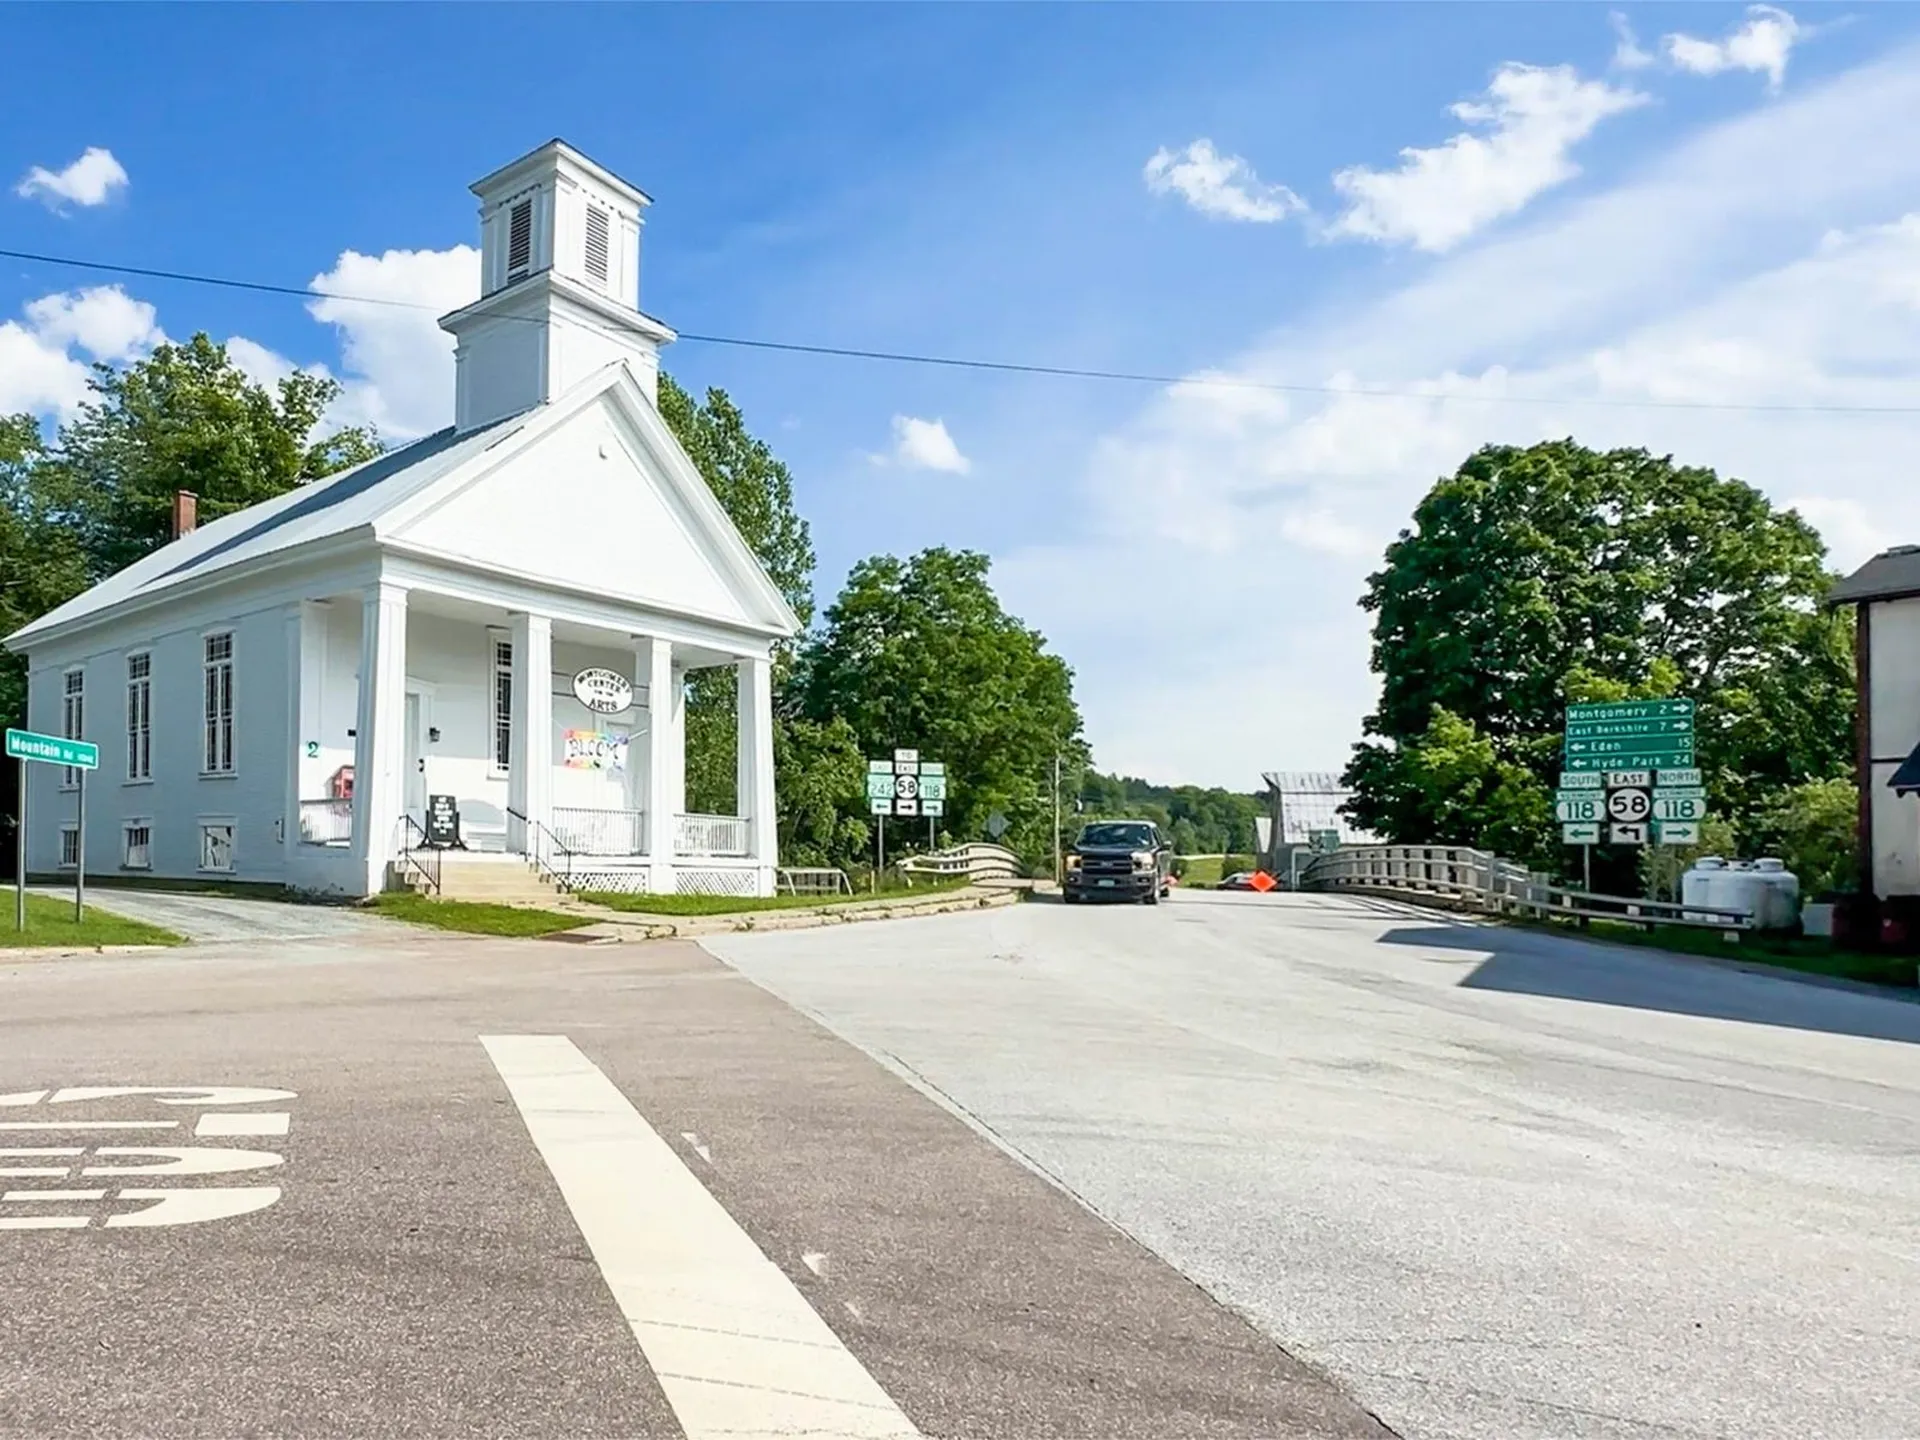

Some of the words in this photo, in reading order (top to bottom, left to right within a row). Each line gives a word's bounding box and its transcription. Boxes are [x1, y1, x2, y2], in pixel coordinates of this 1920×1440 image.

[588, 680, 620, 692] CENTER
[589, 698, 618, 711] ARTS
[1568, 706, 1648, 720] Montgomery
[1659, 705, 1668, 715] 2
[1568, 727, 1591, 736] East
[1596, 724, 1648, 734] Berkshire
[1660, 722, 1667, 732] 7
[11, 735, 60, 758] Mountain
[307, 741, 319, 758] 2
[1590, 741, 1622, 751] Eden
[1678, 737, 1691, 747] 15
[1591, 758, 1623, 769] Hyde
[1632, 756, 1661, 767] Park
[1673, 755, 1690, 765] 24
[1563, 774, 1600, 786] SOUTH
[1613, 773, 1643, 784] EAST
[1659, 770, 1700, 782] NORTH
[871, 783, 893, 796] 242
[898, 780, 916, 794] 58
[924, 785, 940, 797] 118
[1566, 802, 1595, 819] 118
[1612, 796, 1646, 814] 58
[1664, 800, 1695, 818] 118
